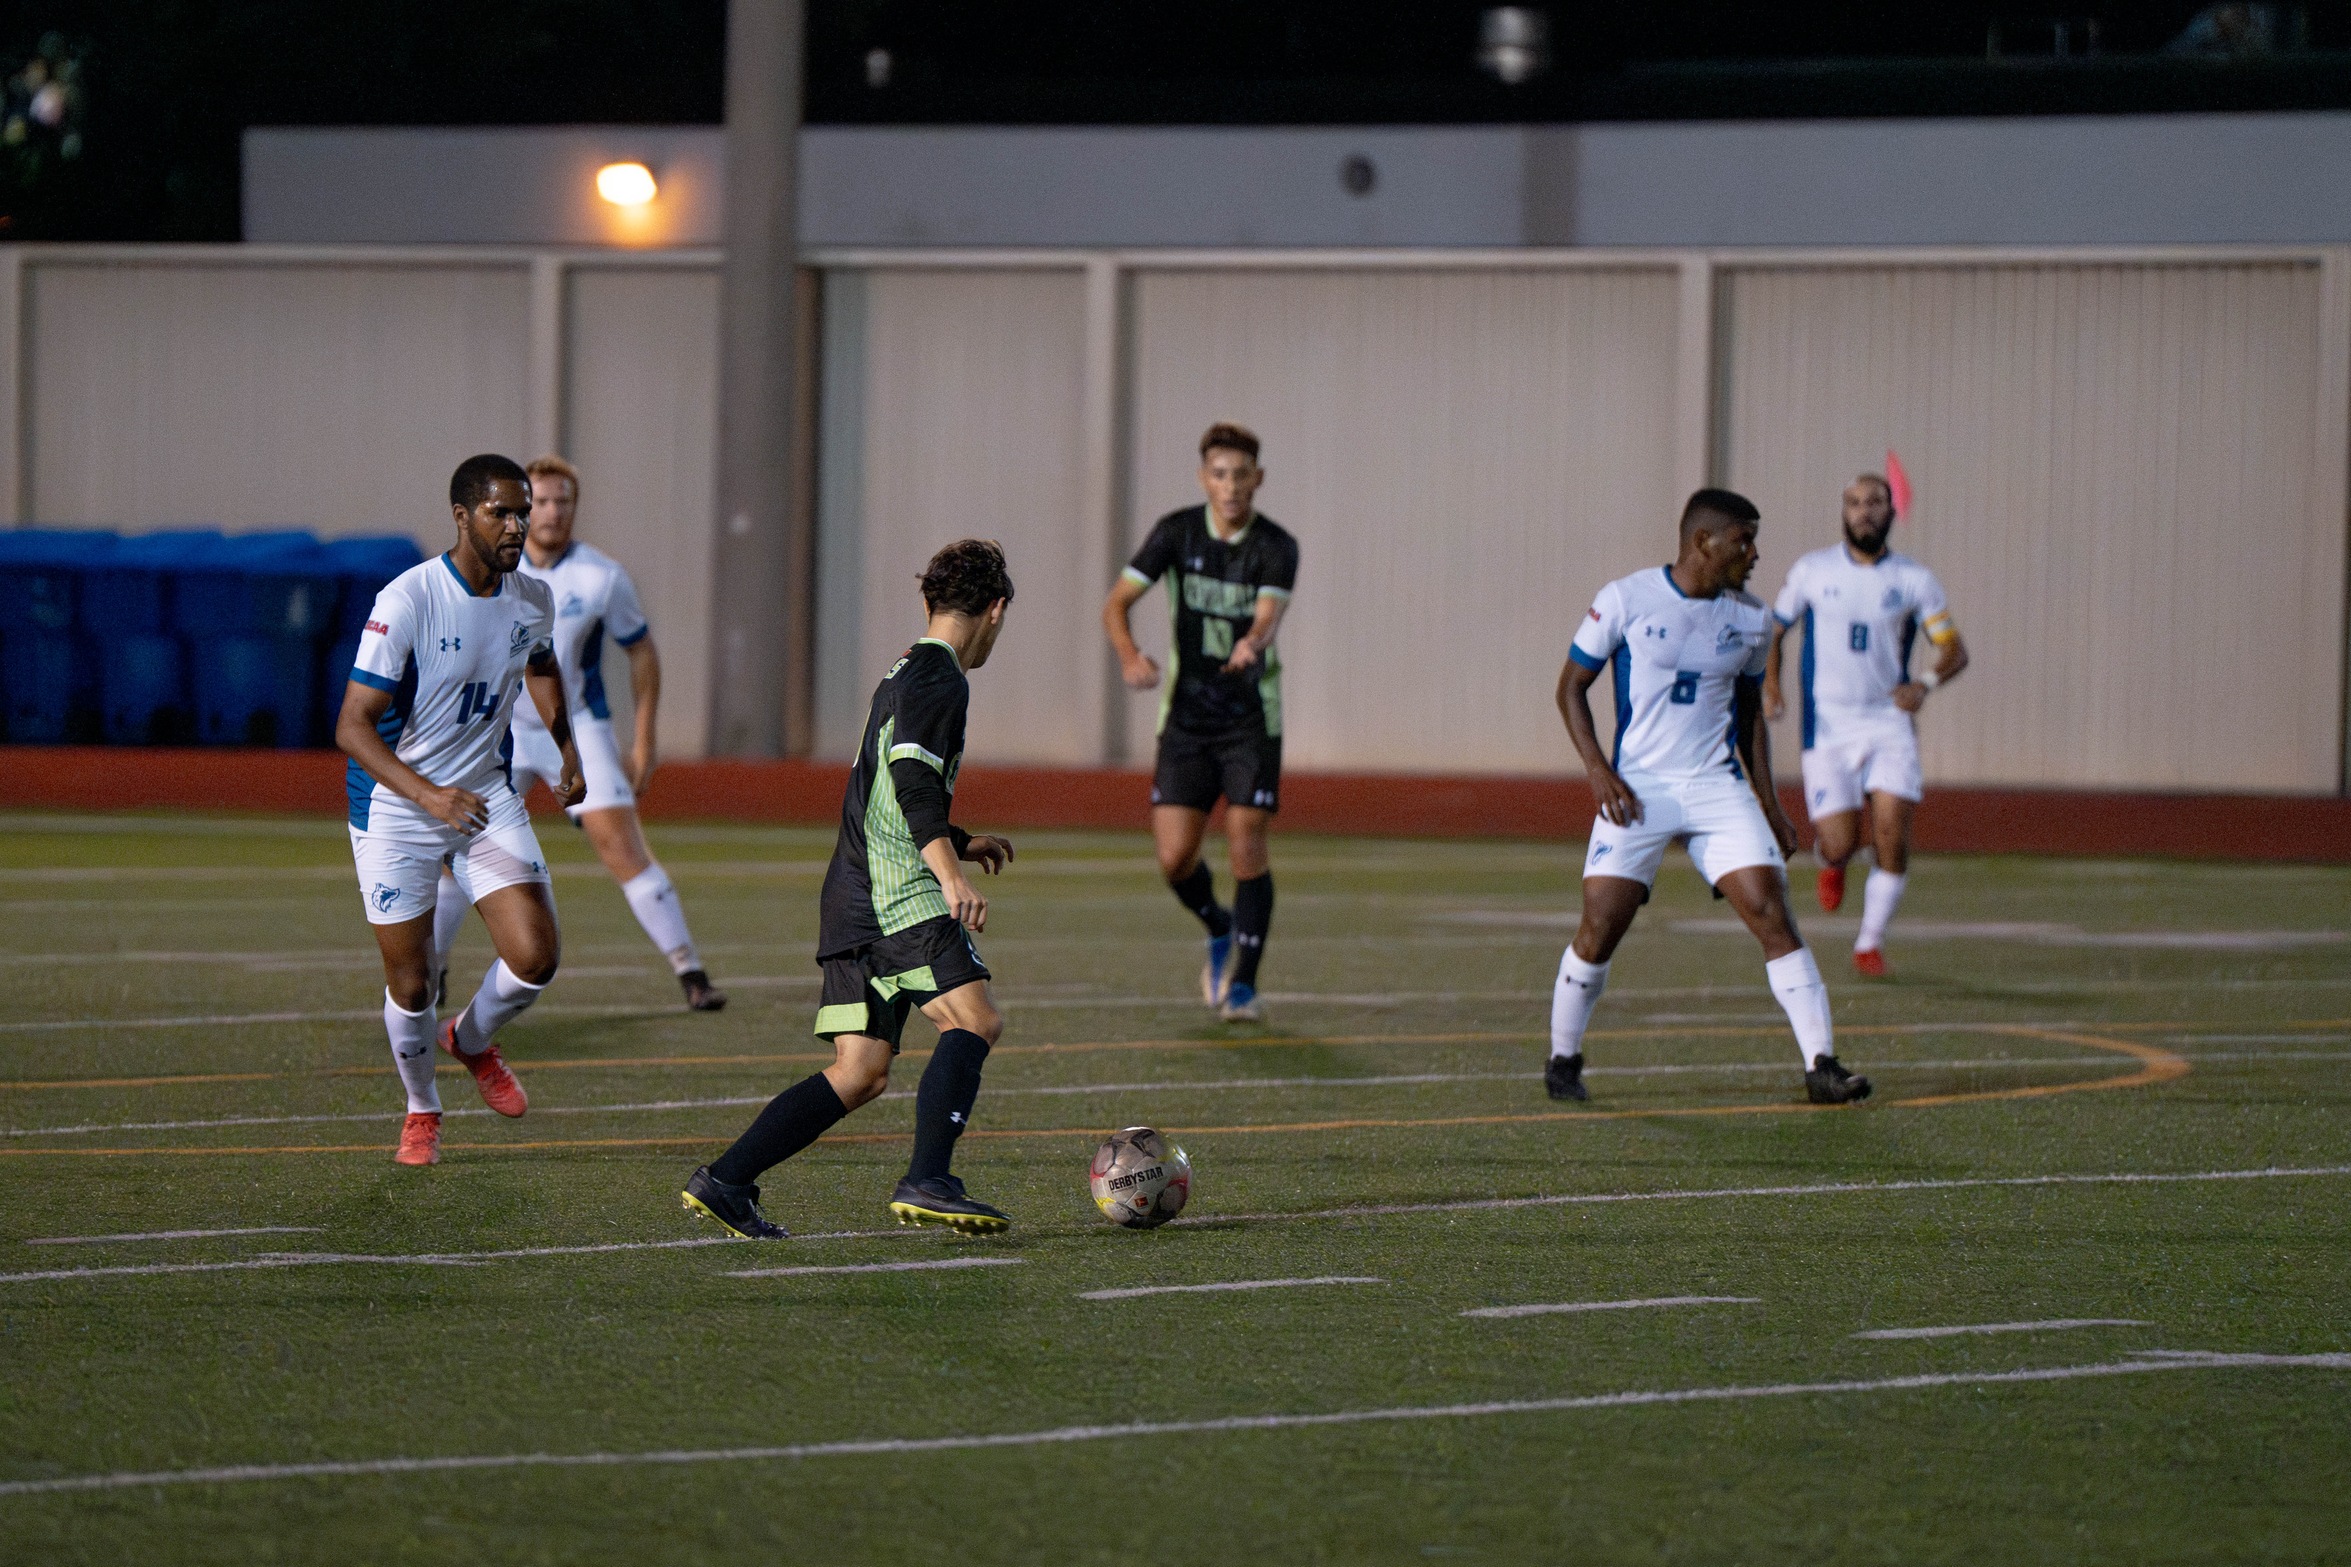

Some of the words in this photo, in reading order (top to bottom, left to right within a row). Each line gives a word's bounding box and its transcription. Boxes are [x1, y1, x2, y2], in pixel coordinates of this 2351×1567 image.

[456, 681, 500, 724] 14
[1670, 670, 1702, 704] 6
[1108, 1166, 1164, 1191] DERBYSTAR
